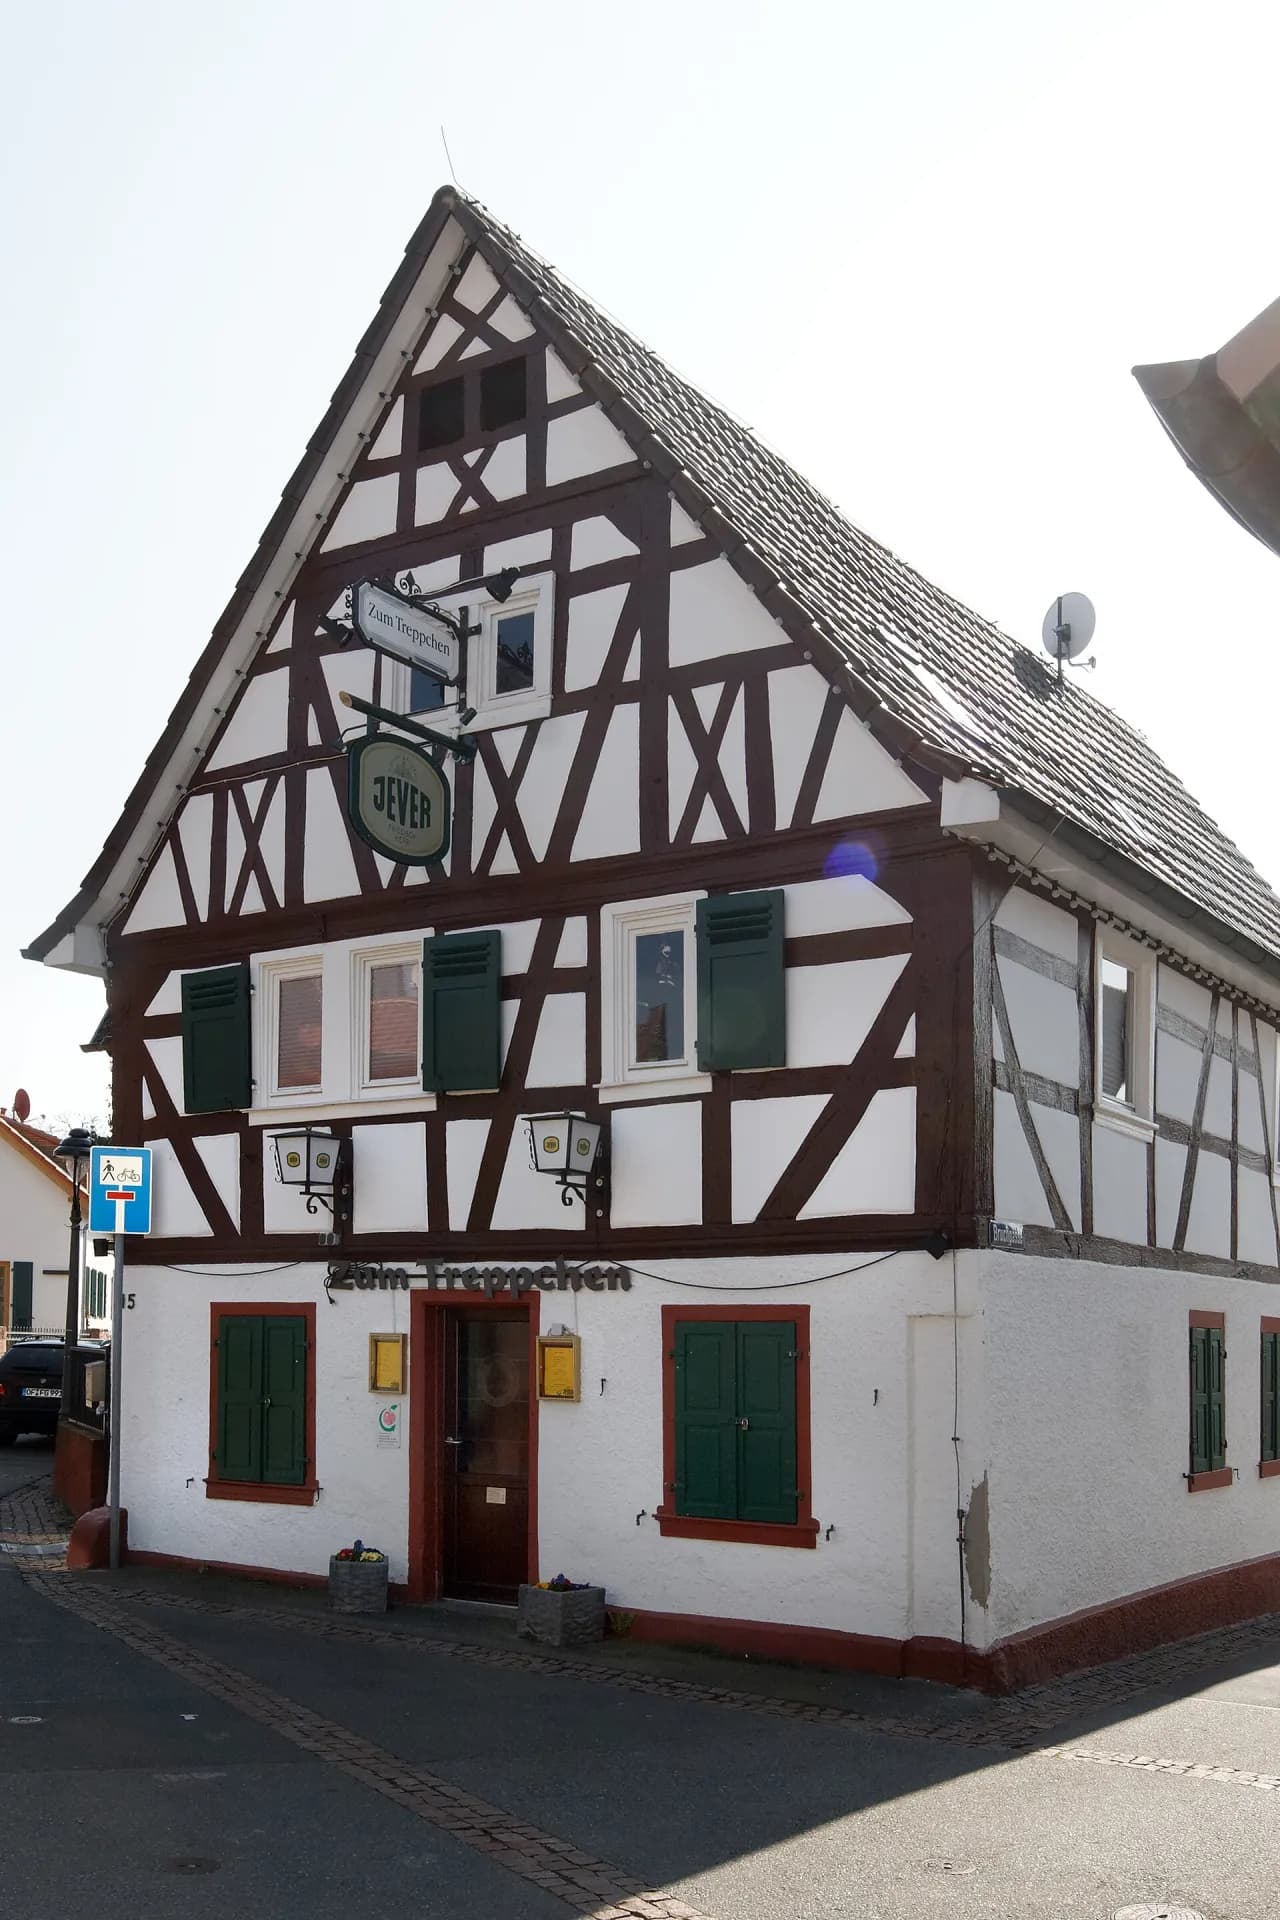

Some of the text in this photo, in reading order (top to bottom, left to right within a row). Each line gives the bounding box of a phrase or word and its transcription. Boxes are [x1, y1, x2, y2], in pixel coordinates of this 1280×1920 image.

[368, 602, 450, 656] Zum Treppchen
[373, 775, 432, 829] JEVER
[327, 1254, 633, 1300] Zum Treppchen
